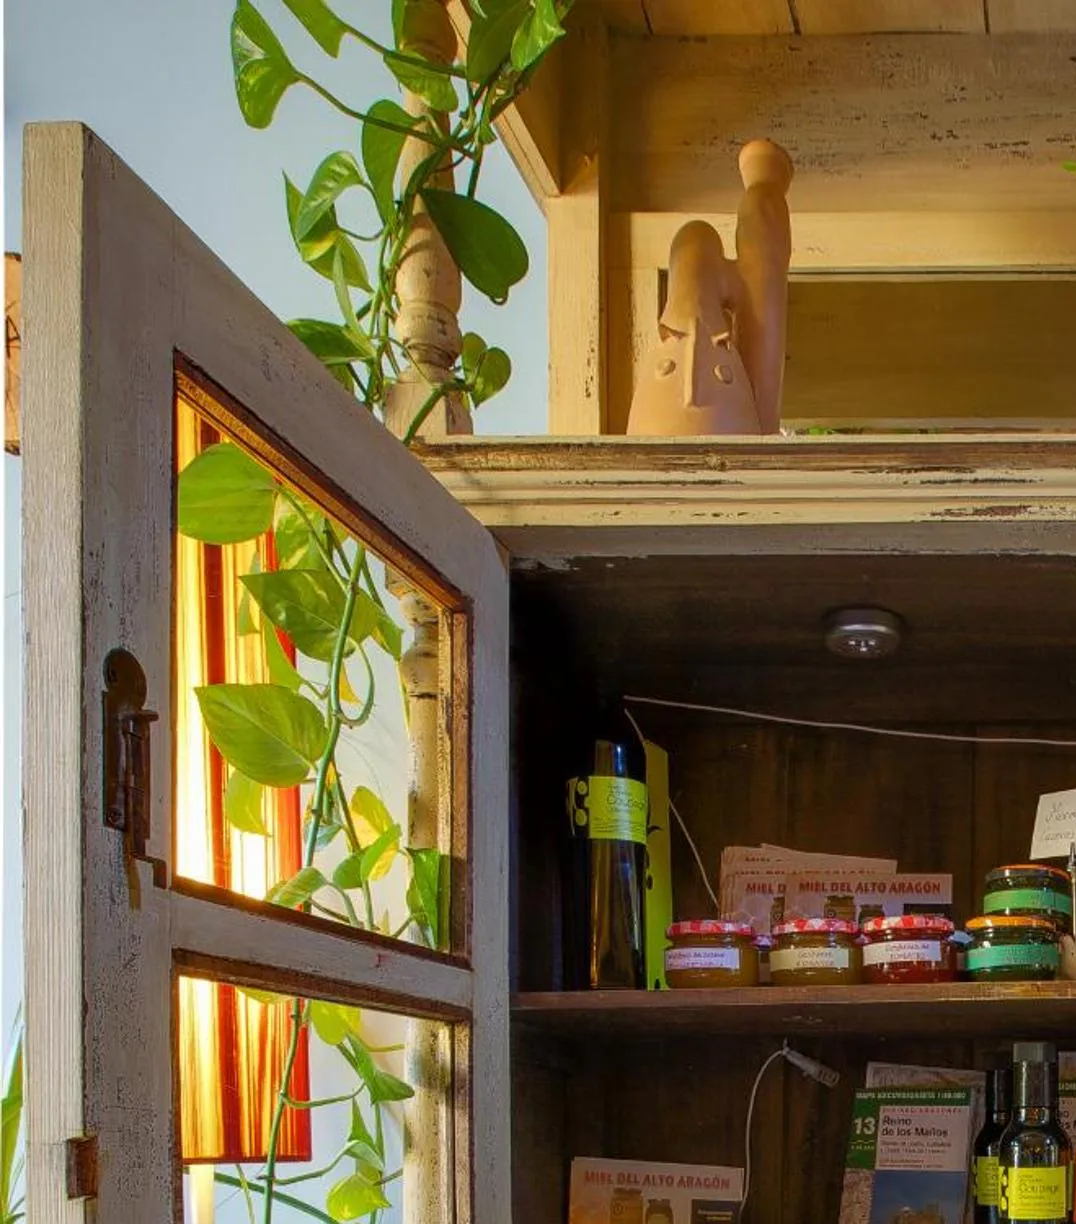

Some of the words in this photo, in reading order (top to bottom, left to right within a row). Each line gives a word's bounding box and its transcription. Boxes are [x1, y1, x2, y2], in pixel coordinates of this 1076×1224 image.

[800, 881, 828, 893] MIEL
[831, 881, 851, 893] DEL
[855, 882, 887, 894] ALTO
[888, 879, 941, 895] ARAGÓN
[853, 1116, 876, 1135] 13
[881, 1127, 895, 1137] de
[896, 1127, 912, 1137] los
[914, 1127, 949, 1137] Mallos
[584, 1170, 613, 1184] MIEL
[617, 1172, 641, 1186] DEL
[642, 1174, 674, 1187] ALTO
[676, 1174, 731, 1190] ARAGÓN
